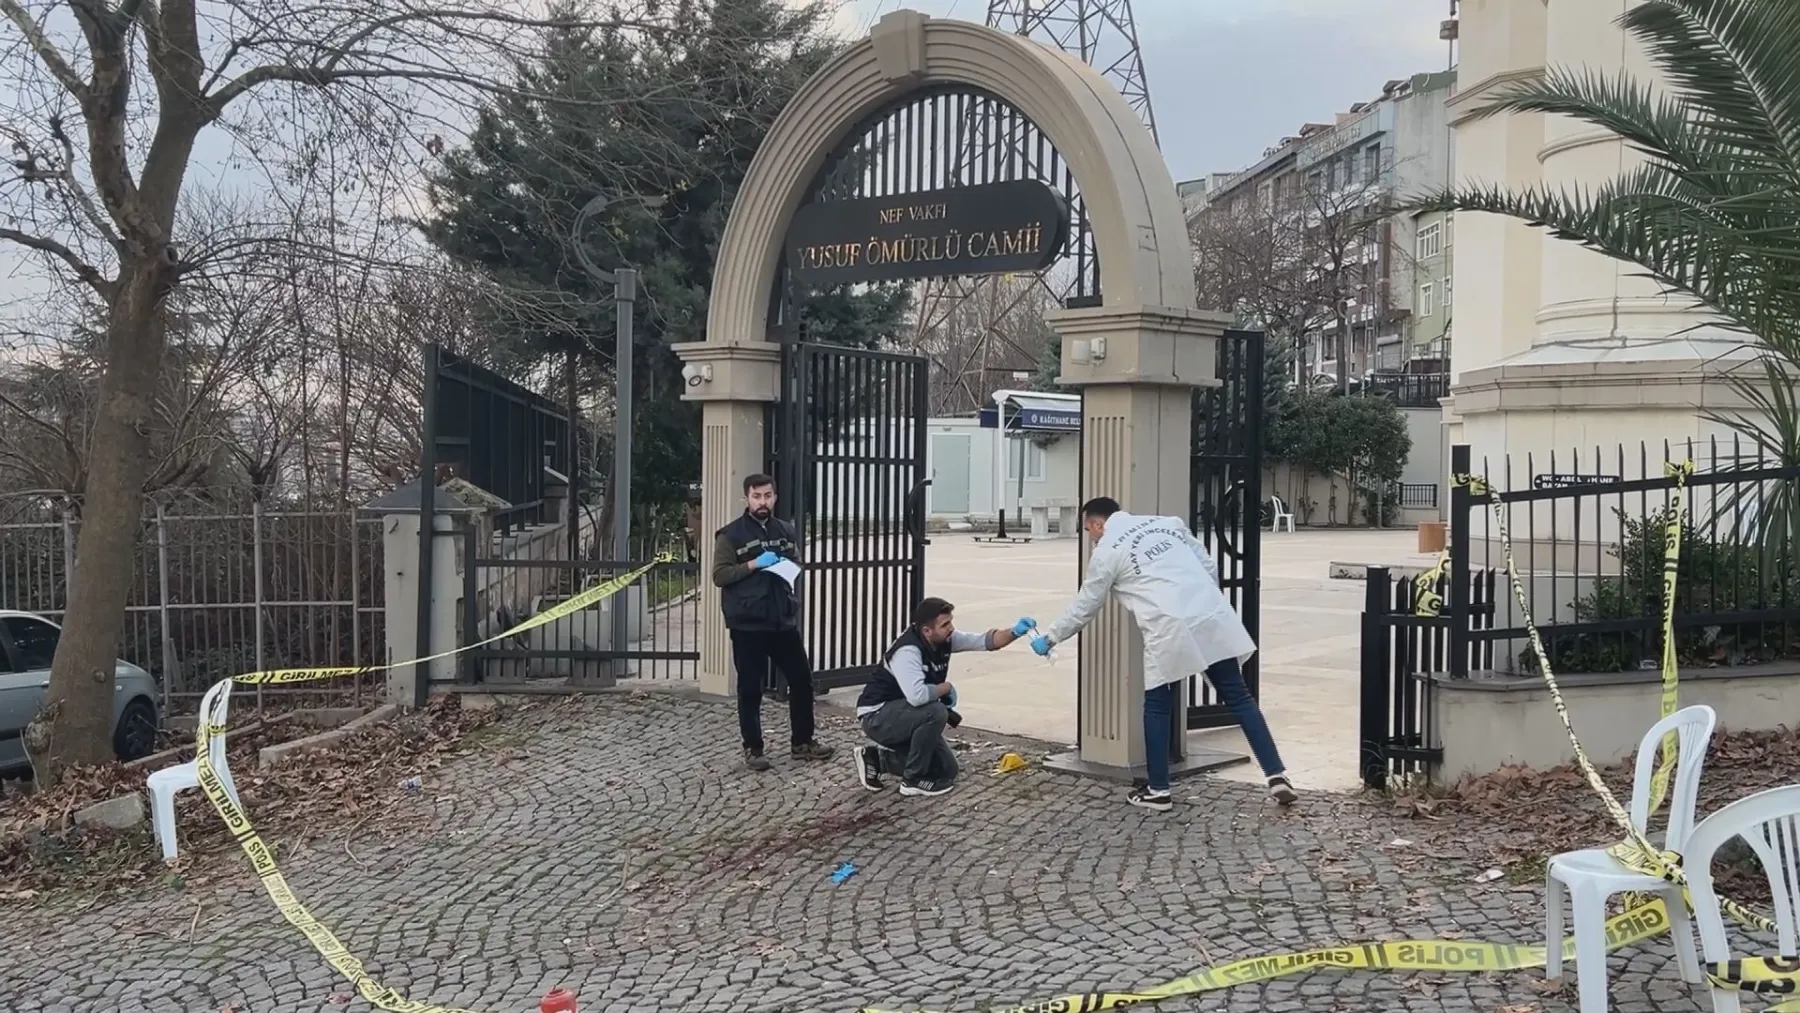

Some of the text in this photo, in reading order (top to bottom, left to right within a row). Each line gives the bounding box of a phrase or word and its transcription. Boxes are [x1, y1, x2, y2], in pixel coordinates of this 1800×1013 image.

[880, 203, 948, 224] NEF VAKFI
[798, 221, 1042, 270] YUSUF ÖMÜRLÜ CAMİİ
